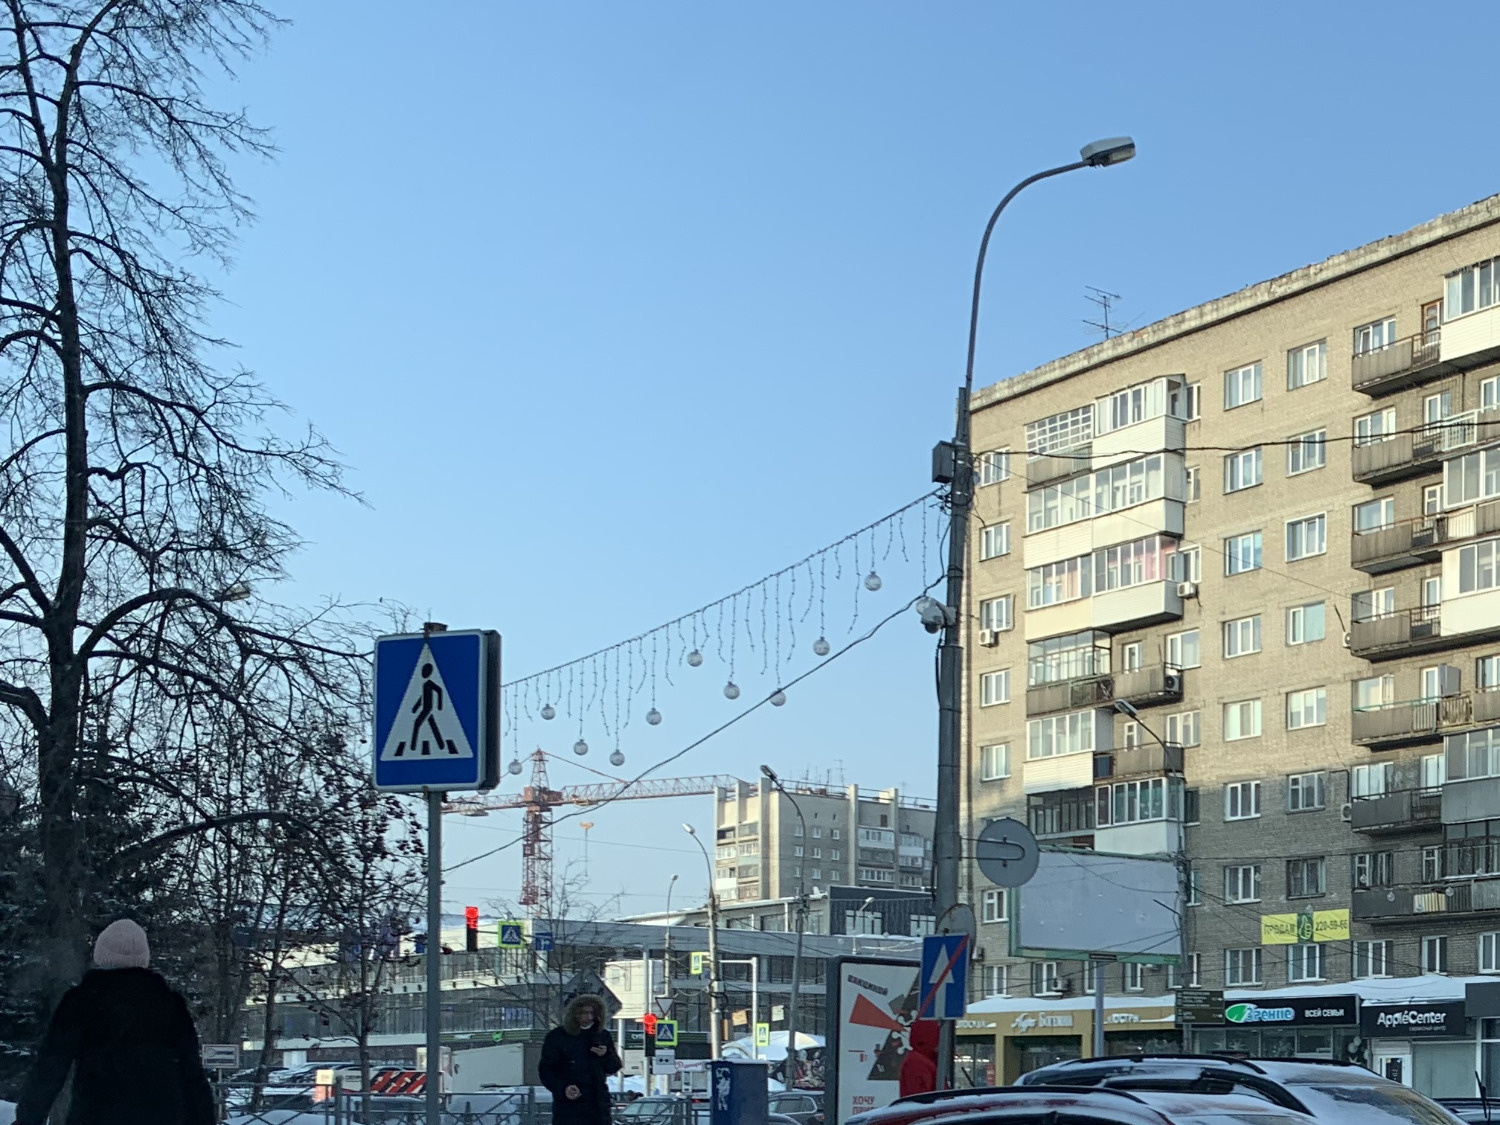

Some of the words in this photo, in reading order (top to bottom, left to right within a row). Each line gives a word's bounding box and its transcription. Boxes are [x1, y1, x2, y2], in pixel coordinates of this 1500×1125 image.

[1304, 1008, 1322, 1018] ВСЕЙ
[1322, 1007, 1344, 1017] СЕМЬИ
[852, 1096, 876, 1106] ХОЧУ
